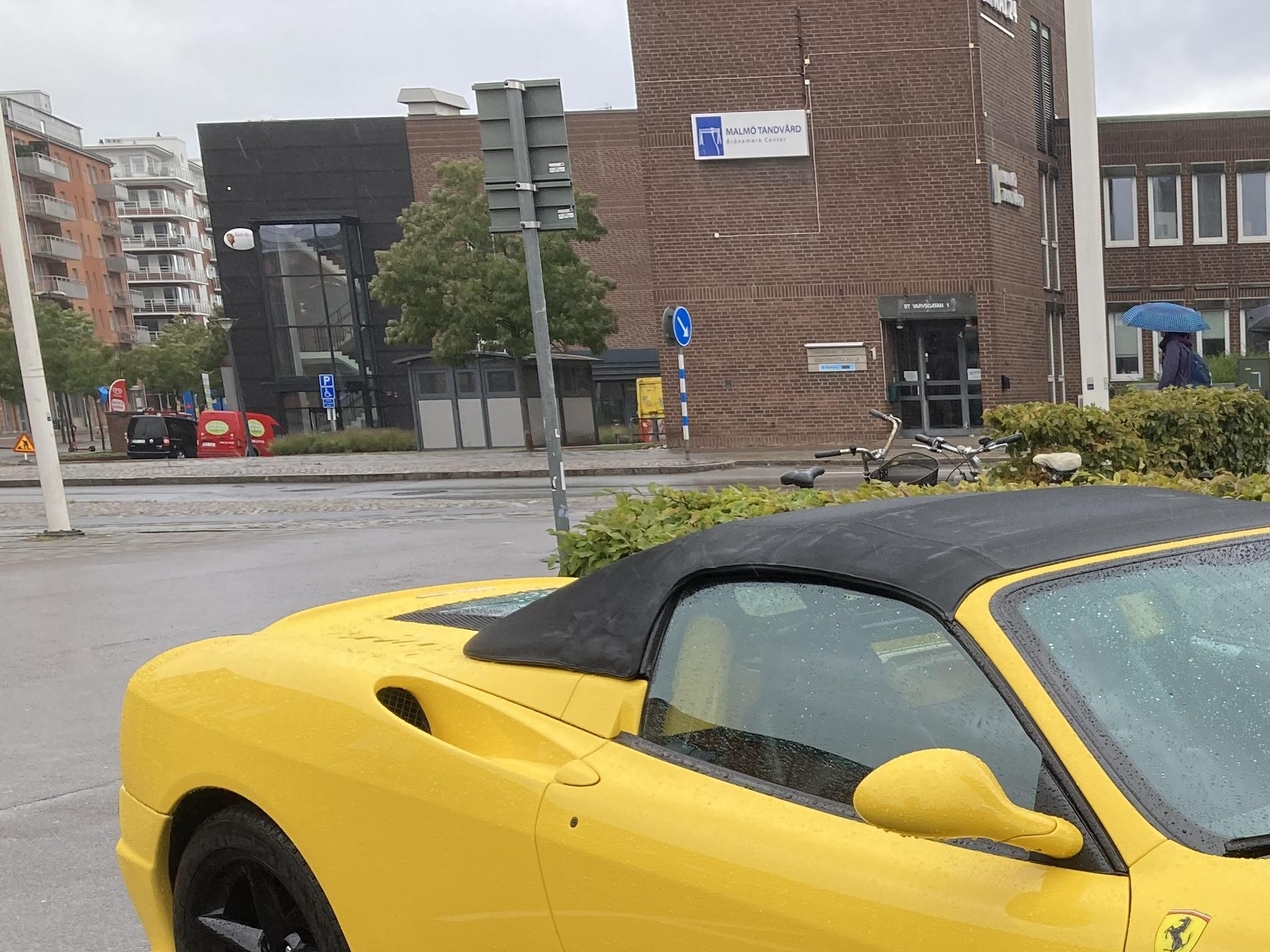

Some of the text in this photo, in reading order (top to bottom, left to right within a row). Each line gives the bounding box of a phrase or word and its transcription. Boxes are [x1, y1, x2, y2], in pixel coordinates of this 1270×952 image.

[726, 124, 802, 136] MALMÖ TANDVÅRD
[870, 346, 877, 360] 1
[323, 376, 331, 386] P
